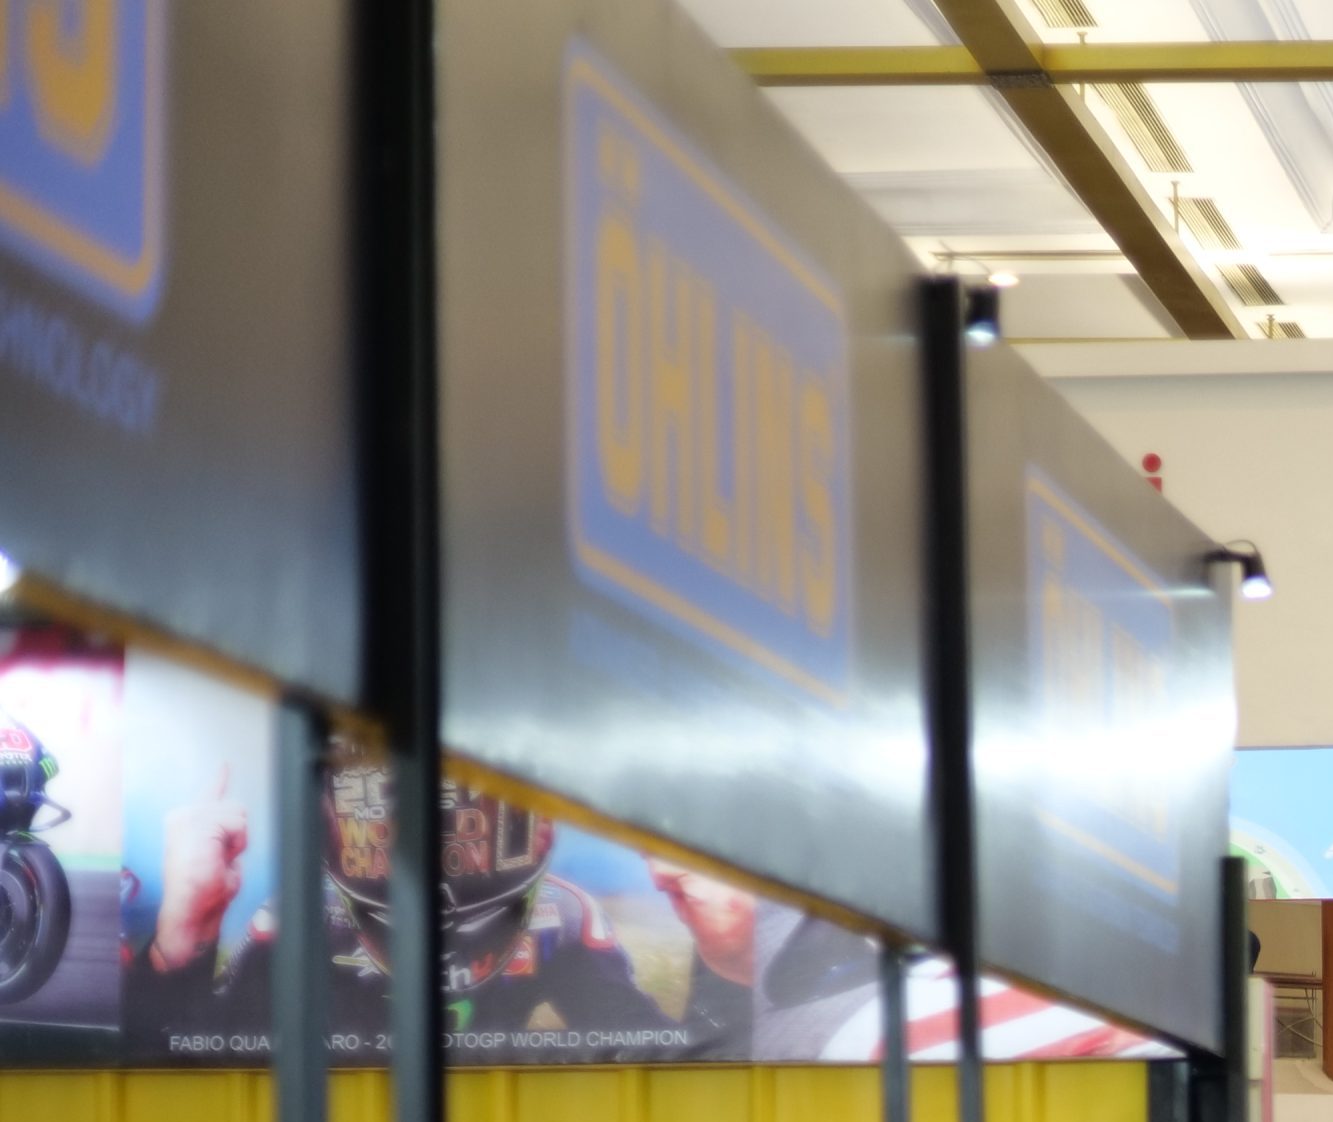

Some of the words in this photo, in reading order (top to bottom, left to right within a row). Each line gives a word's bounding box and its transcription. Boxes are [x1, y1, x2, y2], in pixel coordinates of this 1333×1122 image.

[169, 1034, 224, 1051] FABIO
[442, 1032, 506, 1049] TOGP
[511, 1031, 581, 1048] WORLD
[586, 1029, 688, 1047] CHAMPION
